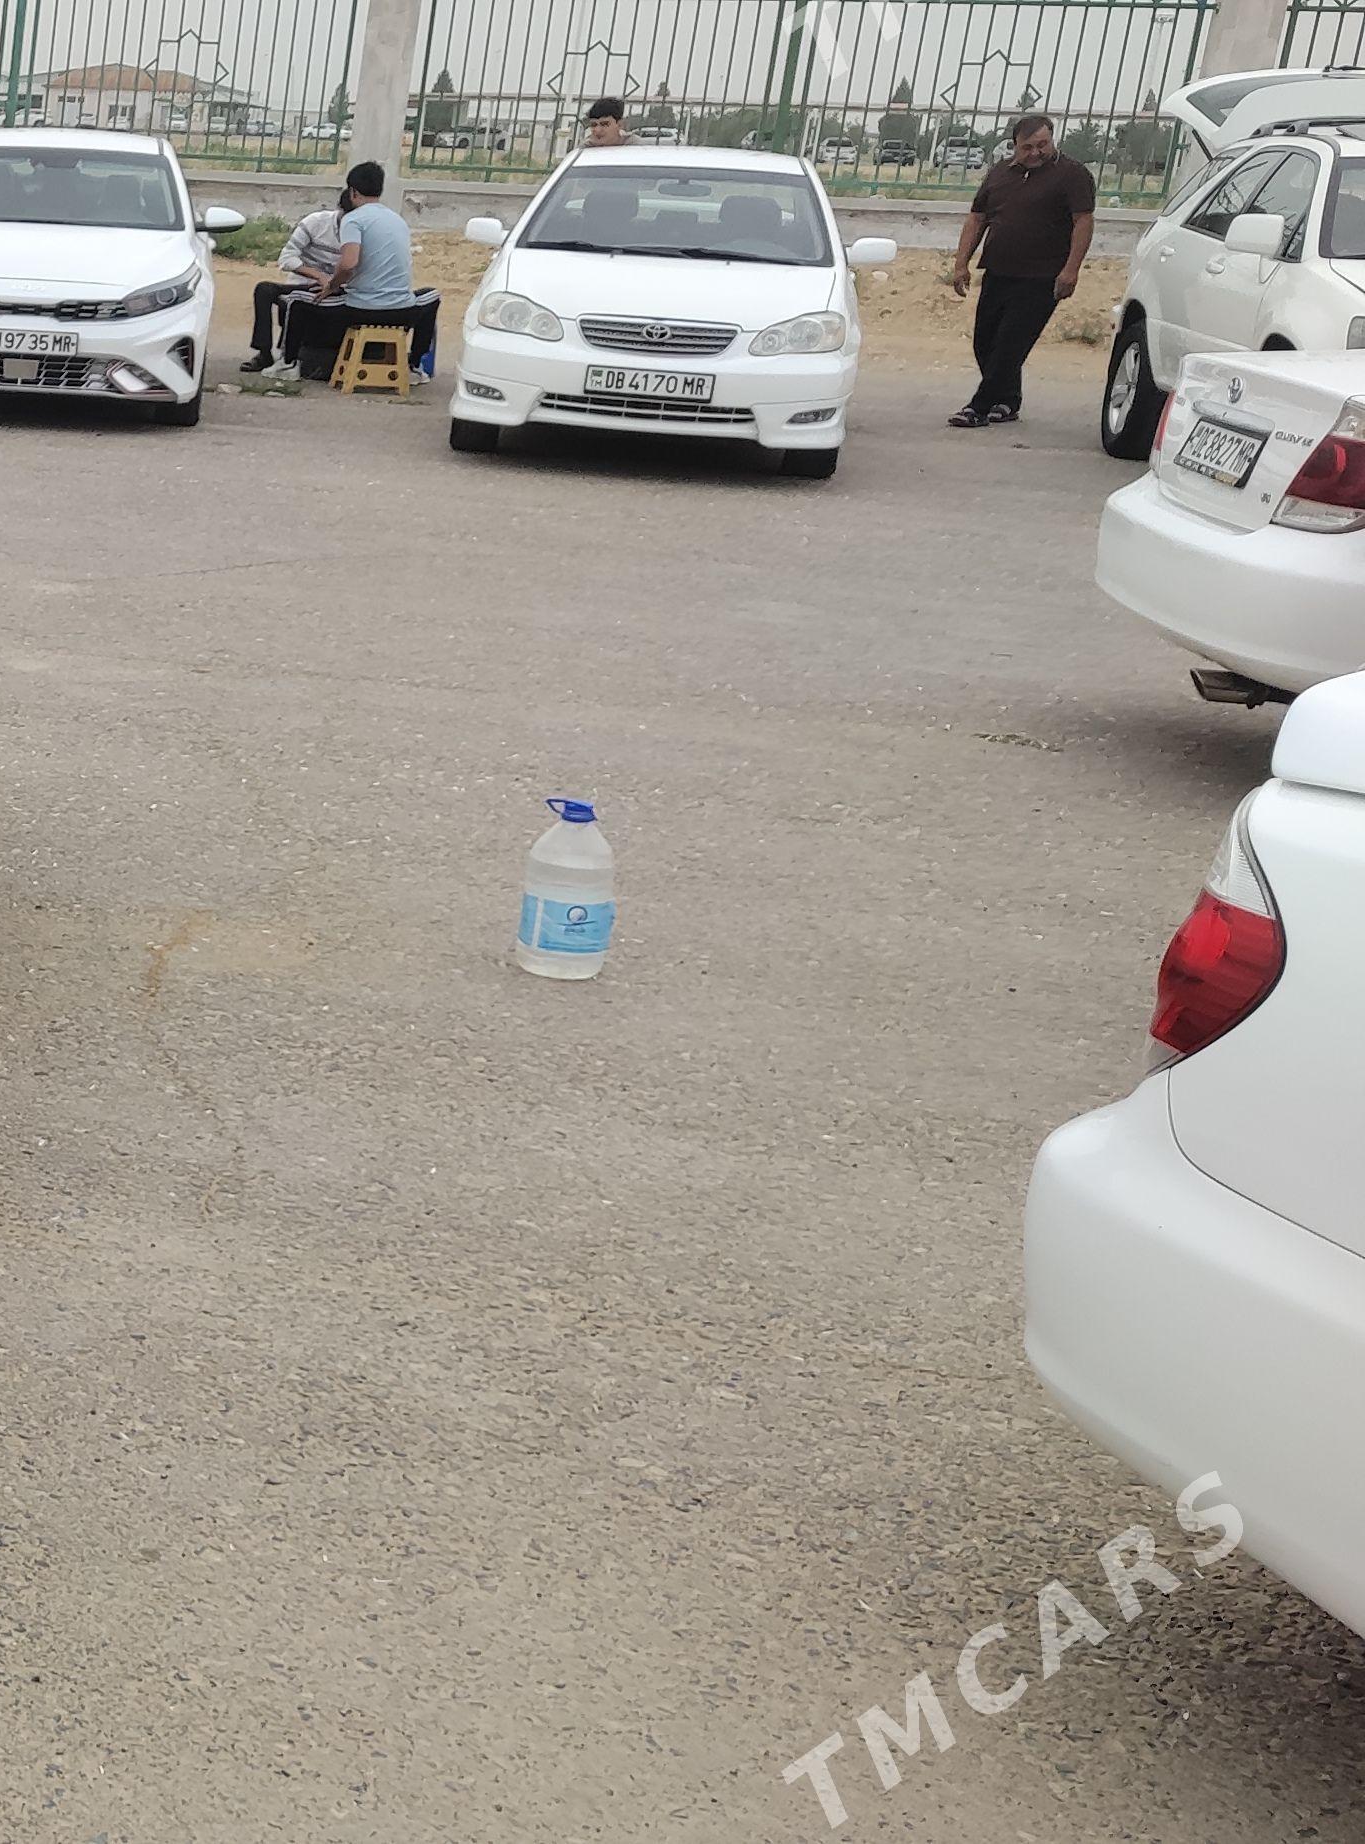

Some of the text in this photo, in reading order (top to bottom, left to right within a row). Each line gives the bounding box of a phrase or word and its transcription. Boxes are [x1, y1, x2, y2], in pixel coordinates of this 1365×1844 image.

[4, 332, 26, 349] 97
[27, 334, 49, 351] 35
[51, 335, 72, 352] MR
[605, 370, 626, 389] DB
[681, 376, 706, 395] MR
